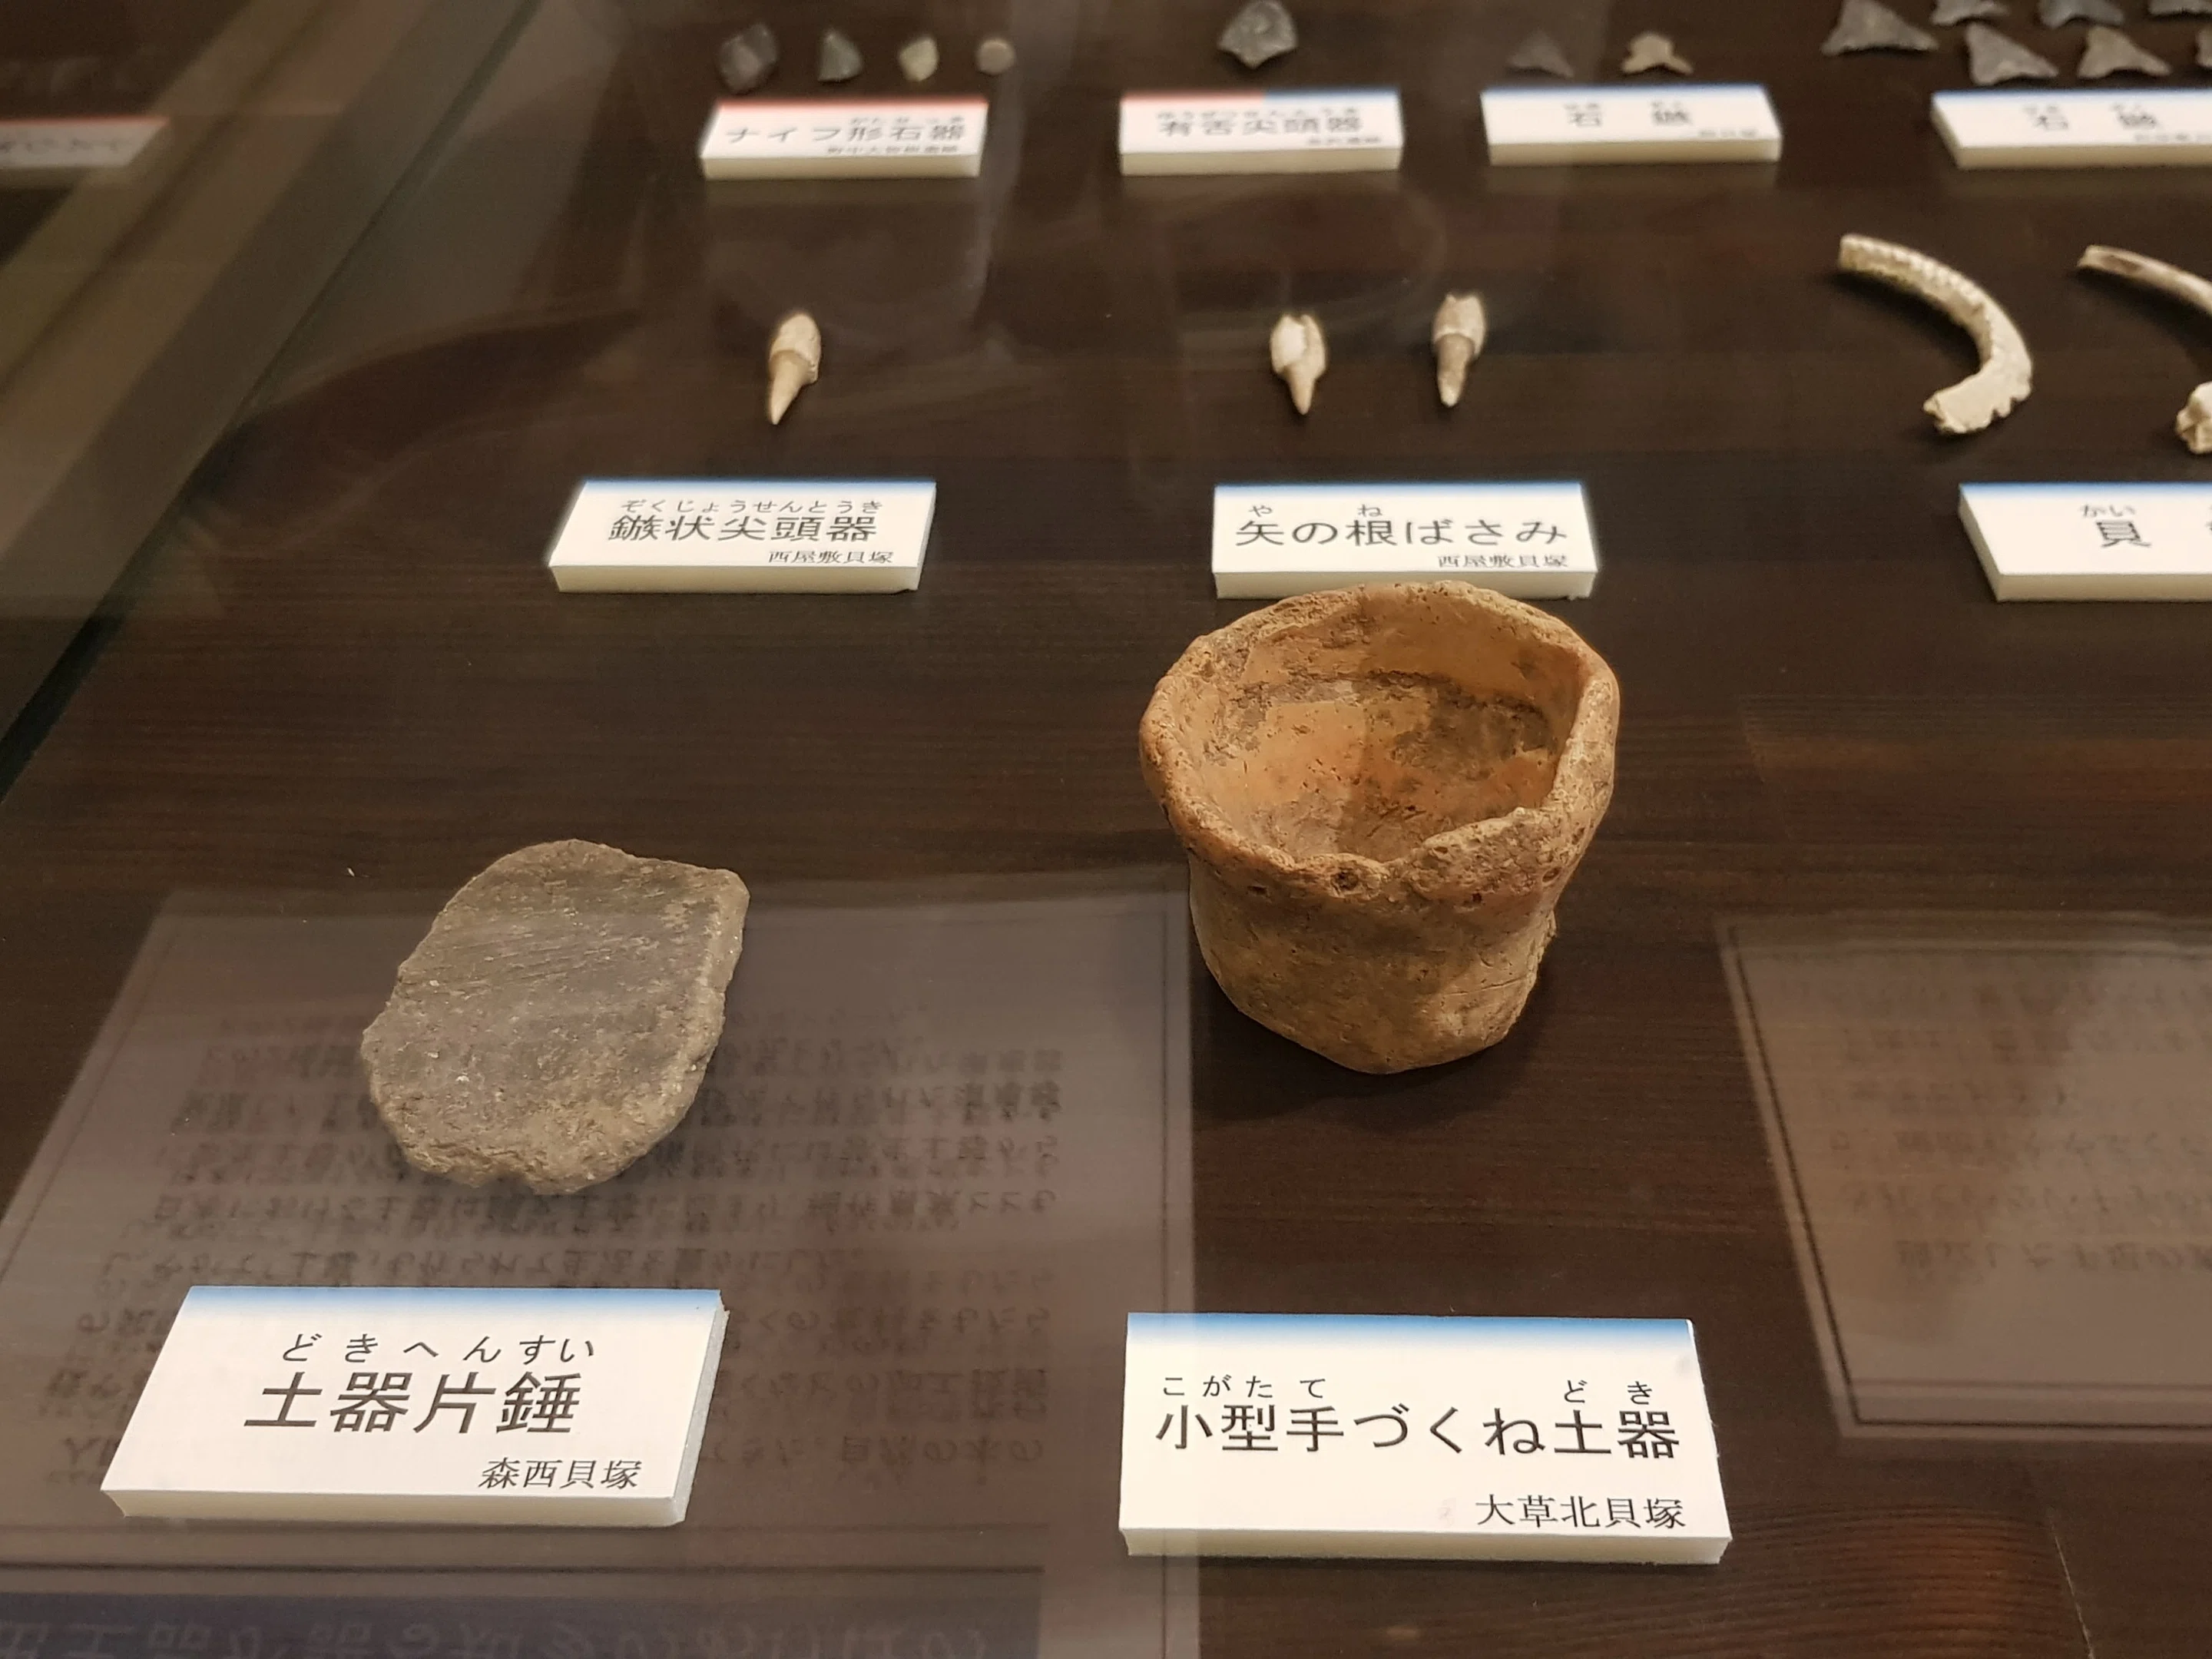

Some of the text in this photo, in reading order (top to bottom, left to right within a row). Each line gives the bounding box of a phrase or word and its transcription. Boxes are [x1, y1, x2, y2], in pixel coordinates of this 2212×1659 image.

[621, 499, 882, 514] ぞくじょうせんとうき
[1250, 503, 1382, 517] や ね
[608, 515, 878, 542] 鏃状尖頭器
[1236, 519, 1568, 547] 矢の根ばさみ
[769, 550, 894, 565] 西屋敷貝塚
[1438, 553, 1569, 569] 西屋敷貝塚
[281, 1333, 597, 1365] どきへんすい
[243, 1370, 583, 1435] 土器片錘
[1155, 1402, 1681, 1461] 小型手づくね土器
[478, 1457, 642, 1489] 森西貝塚
[1475, 1494, 1685, 1530] 大草北貝塚
